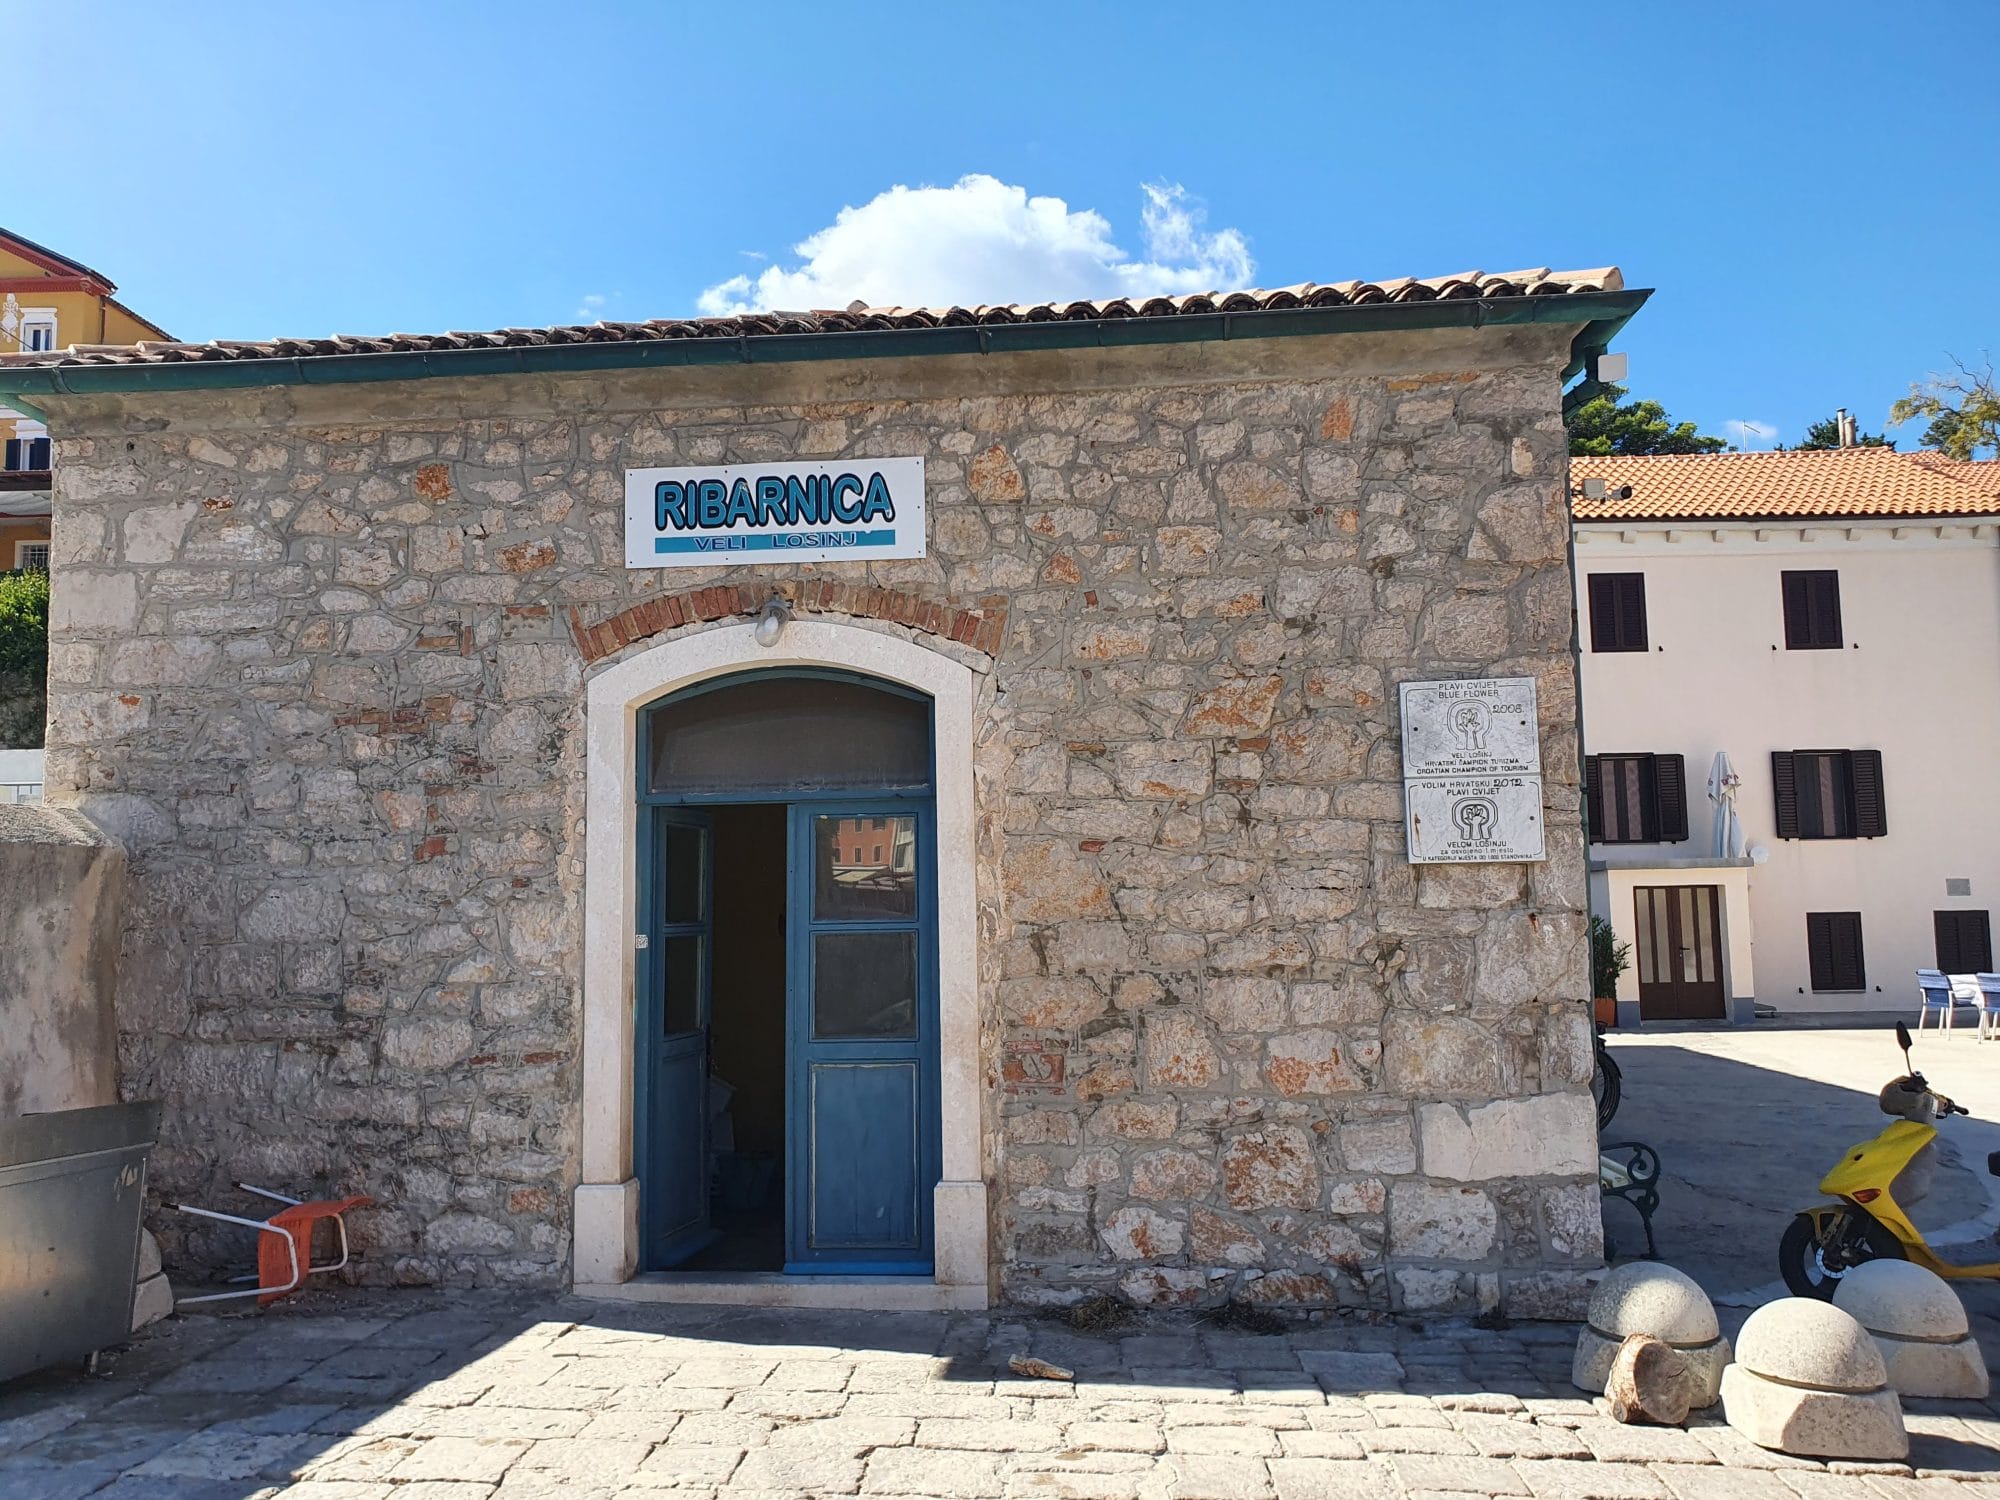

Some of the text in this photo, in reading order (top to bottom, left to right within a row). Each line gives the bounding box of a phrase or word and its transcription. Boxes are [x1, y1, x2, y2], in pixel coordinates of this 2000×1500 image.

[655, 472, 896, 531] RIBARNICA
[694, 536, 747, 551] VELI
[1467, 681, 1497, 690] CVIJET
[1463, 690, 1499, 698] FLOWER
[1450, 780, 1489, 788] HRVATSKU
[1472, 787, 1500, 795] CVIJET
